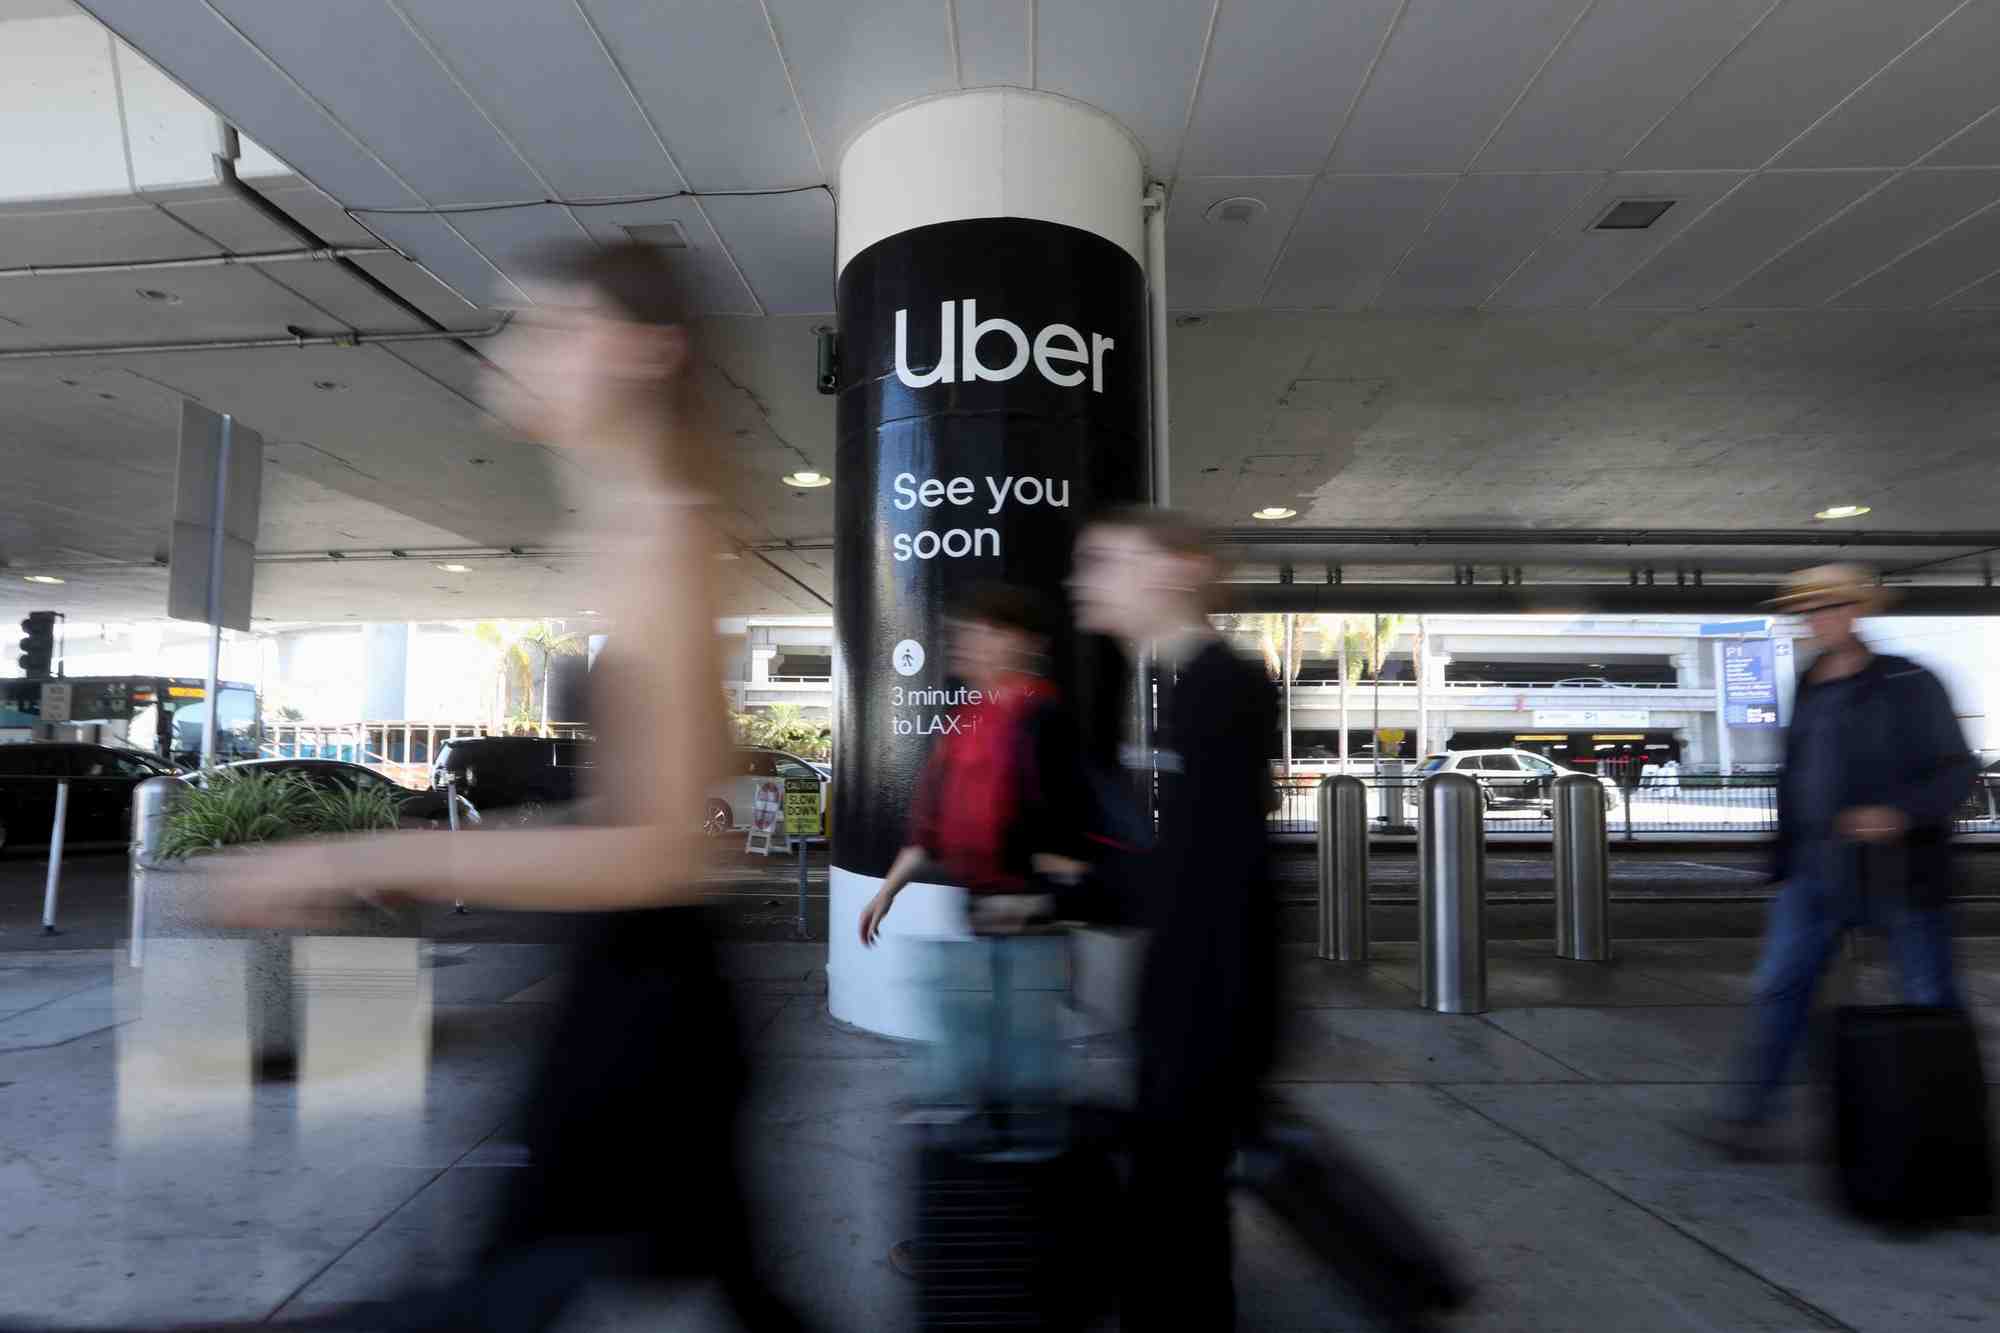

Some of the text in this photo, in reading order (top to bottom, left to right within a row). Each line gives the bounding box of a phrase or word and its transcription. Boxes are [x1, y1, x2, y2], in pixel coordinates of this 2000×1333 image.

[895, 299, 1114, 393] Uber
[894, 473, 1069, 514] See you
[894, 527, 1000, 561] soon
[891, 686, 904, 706] 3
[908, 686, 983, 706] minute
[892, 714, 984, 735] to LAX-i
[789, 794, 816, 805] SLOW
[787, 806, 817, 816] DOWN
